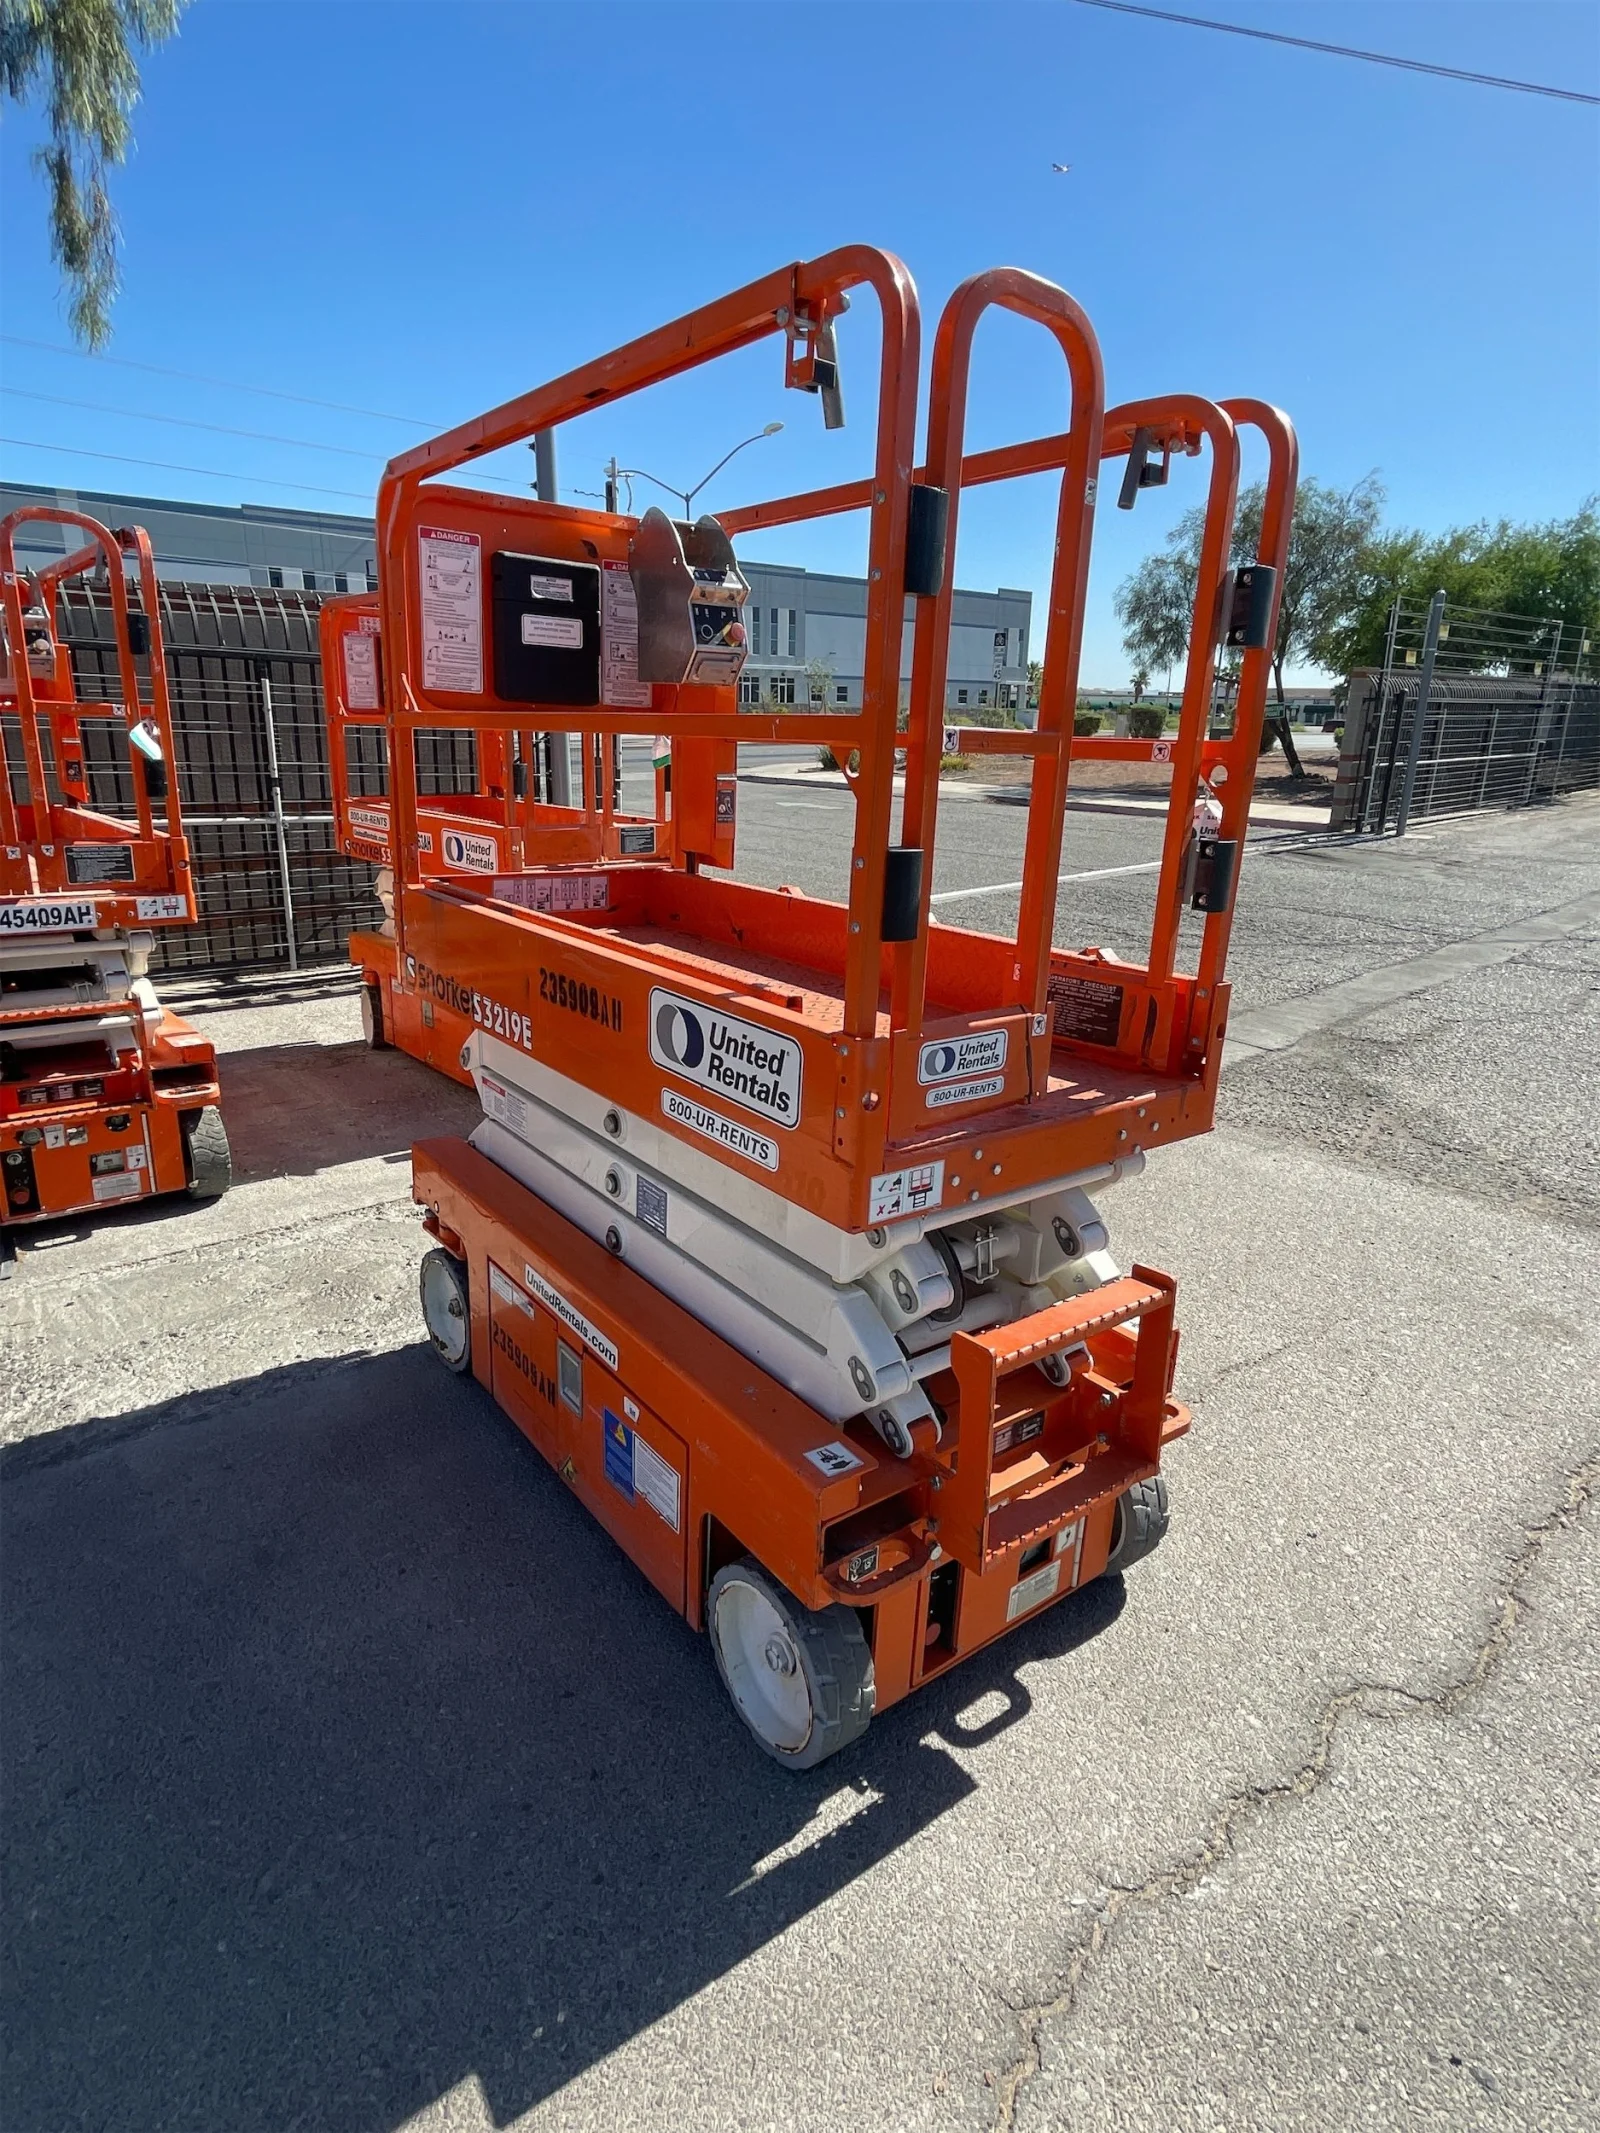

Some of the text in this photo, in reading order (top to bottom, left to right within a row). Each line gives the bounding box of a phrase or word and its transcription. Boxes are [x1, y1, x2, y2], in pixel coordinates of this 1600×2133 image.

[436, 531, 470, 543] DANGER
[465, 840, 492, 855] United
[465, 854, 494, 871] Rentals
[0, 905, 92, 929] 45409AH
[1083, 981, 1117, 993] CHECKLIST
[473, 992, 533, 1050] S3219E
[709, 1022, 786, 1077] United
[959, 1037, 999, 1057] United
[957, 1051, 1000, 1071] Rentals
[707, 1053, 791, 1113] Rentals
[933, 1081, 998, 1102] 800-UR-RENTS
[669, 1097, 770, 1161] 800-UR-RENTS
[527, 1269, 617, 1366] UnitedRentals.com
